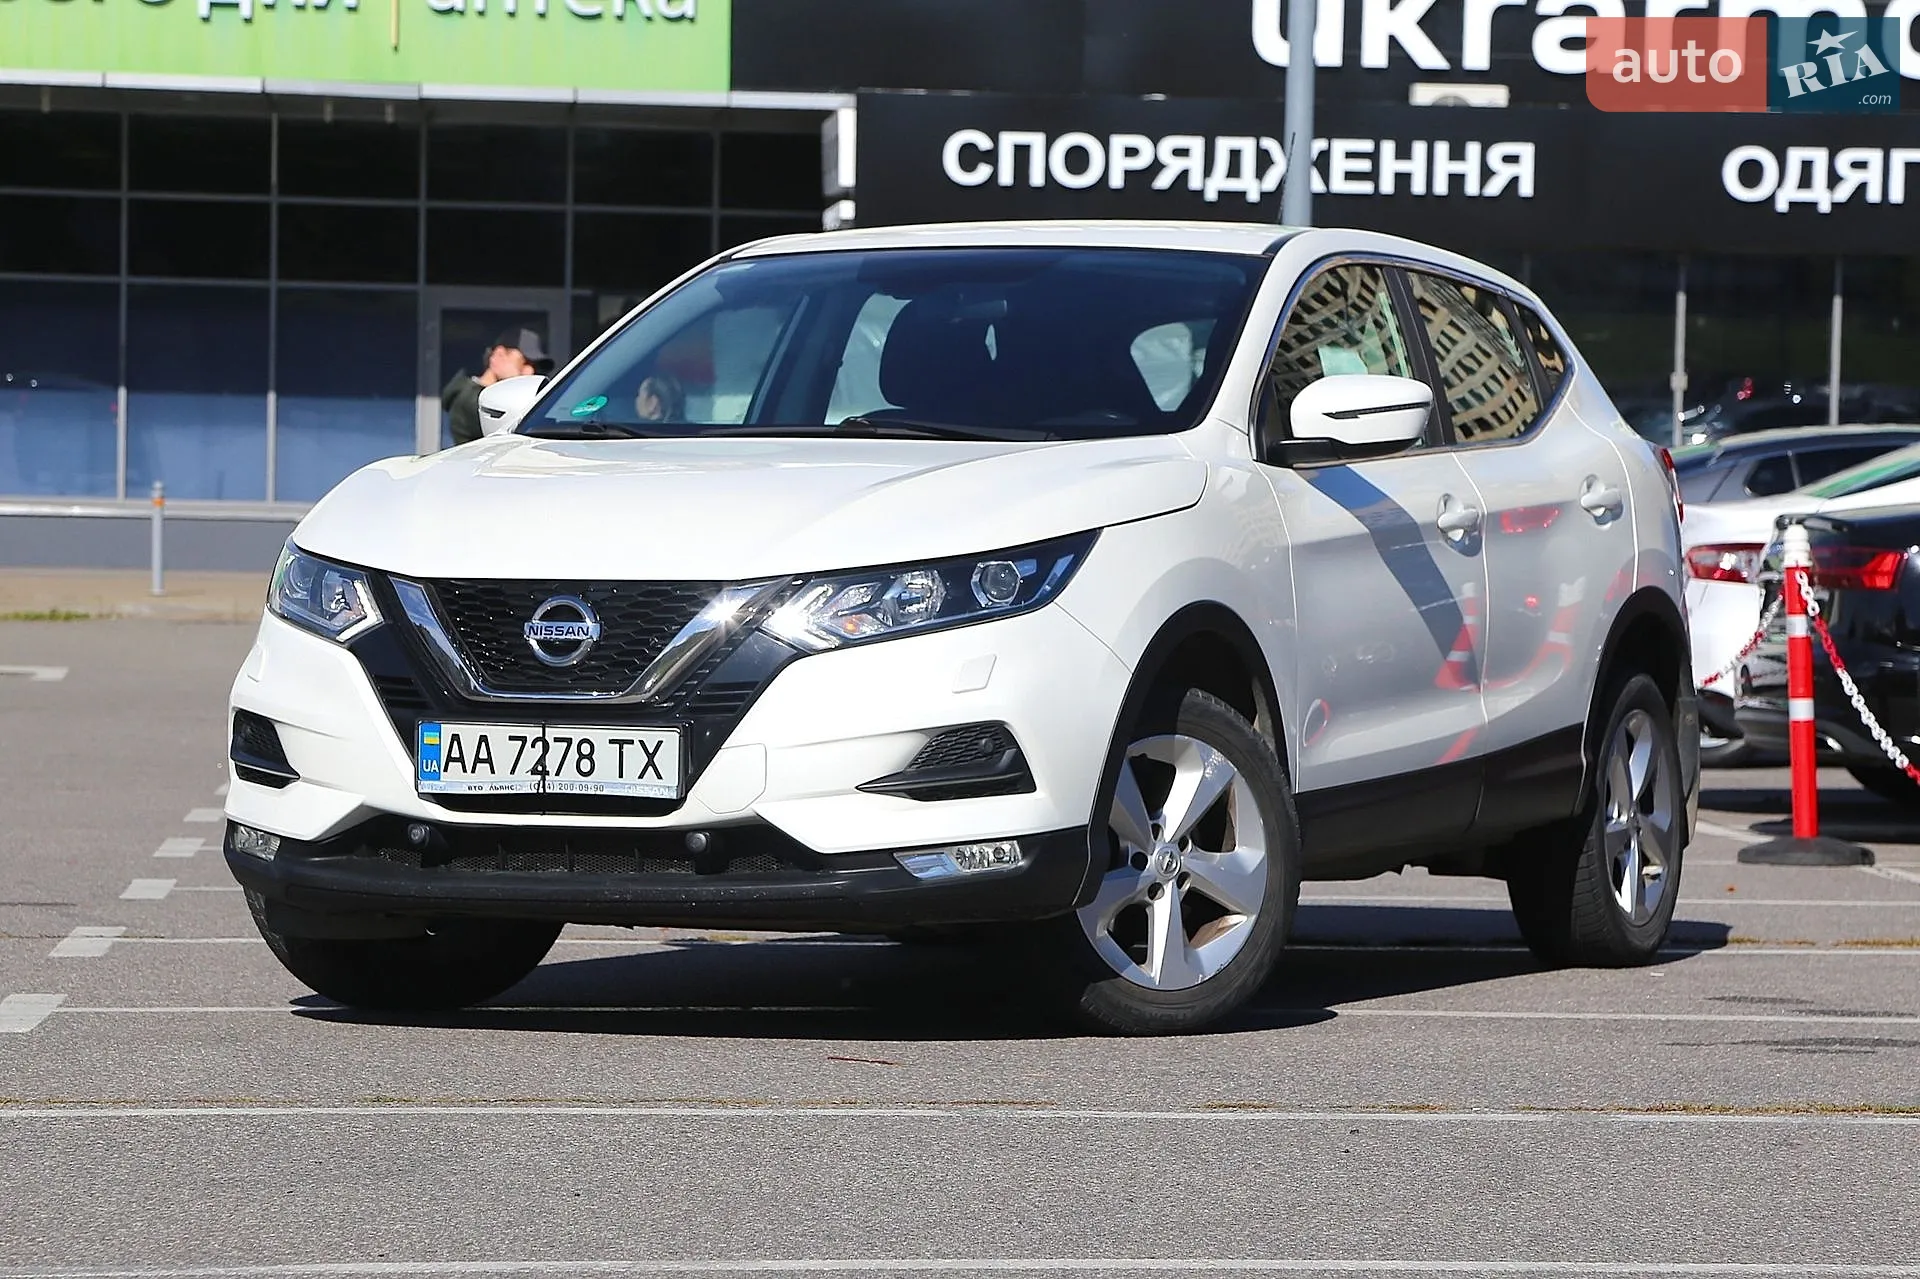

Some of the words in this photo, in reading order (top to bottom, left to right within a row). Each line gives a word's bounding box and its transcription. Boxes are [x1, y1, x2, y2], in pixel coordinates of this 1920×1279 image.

[942, 129, 1535, 204] СПОРЯДЖЕННЯ
[528, 625, 590, 637] NISSAN
[422, 760, 439, 773] UA
[443, 733, 496, 775] AA
[508, 735, 596, 778] 7278
[608, 738, 664, 780] TX
